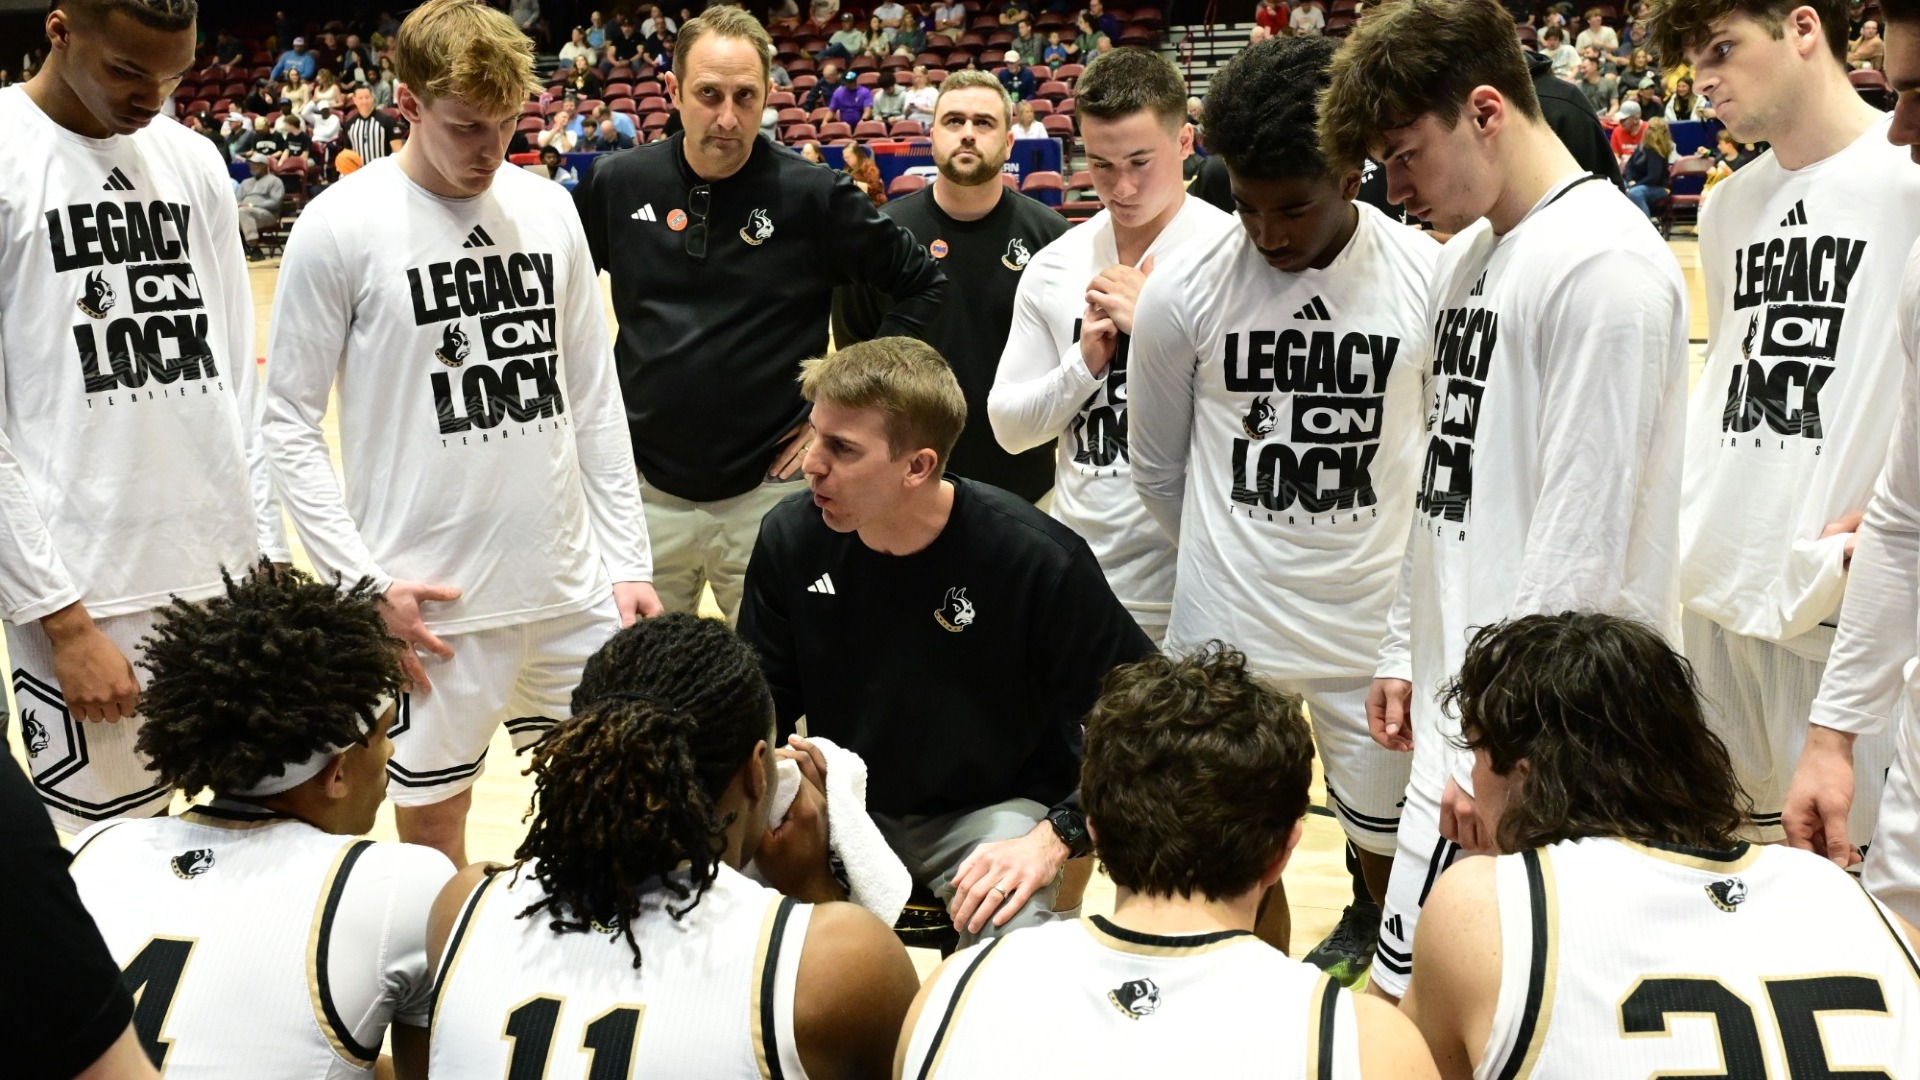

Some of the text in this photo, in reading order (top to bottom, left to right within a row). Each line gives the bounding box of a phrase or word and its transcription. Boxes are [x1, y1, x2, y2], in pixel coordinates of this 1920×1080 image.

[45, 200, 190, 273] LEGACY
[1734, 235, 1867, 311] LEGACY
[135, 273, 201, 302] ON
[407, 252, 554, 326] LEGACY
[73, 313, 219, 393] LOCK
[491, 319, 551, 348] ON
[1224, 329, 1400, 394] LEGACY
[1432, 307, 1498, 381] LEGCY
[1771, 317, 1830, 348] ON
[87, 382, 223, 408] TERRIERS
[430, 354, 564, 434] LOCK
[1301, 407, 1376, 434] ON
[1443, 393, 1475, 425] N
[1722, 359, 1836, 439] LOCK
[442, 418, 567, 447] TERRIERS
[1231, 438, 1380, 513] LOCK
[1230, 505, 1376, 525] TERRIERS
[121, 934, 199, 1080] 4
[501, 992, 646, 1080] 11
